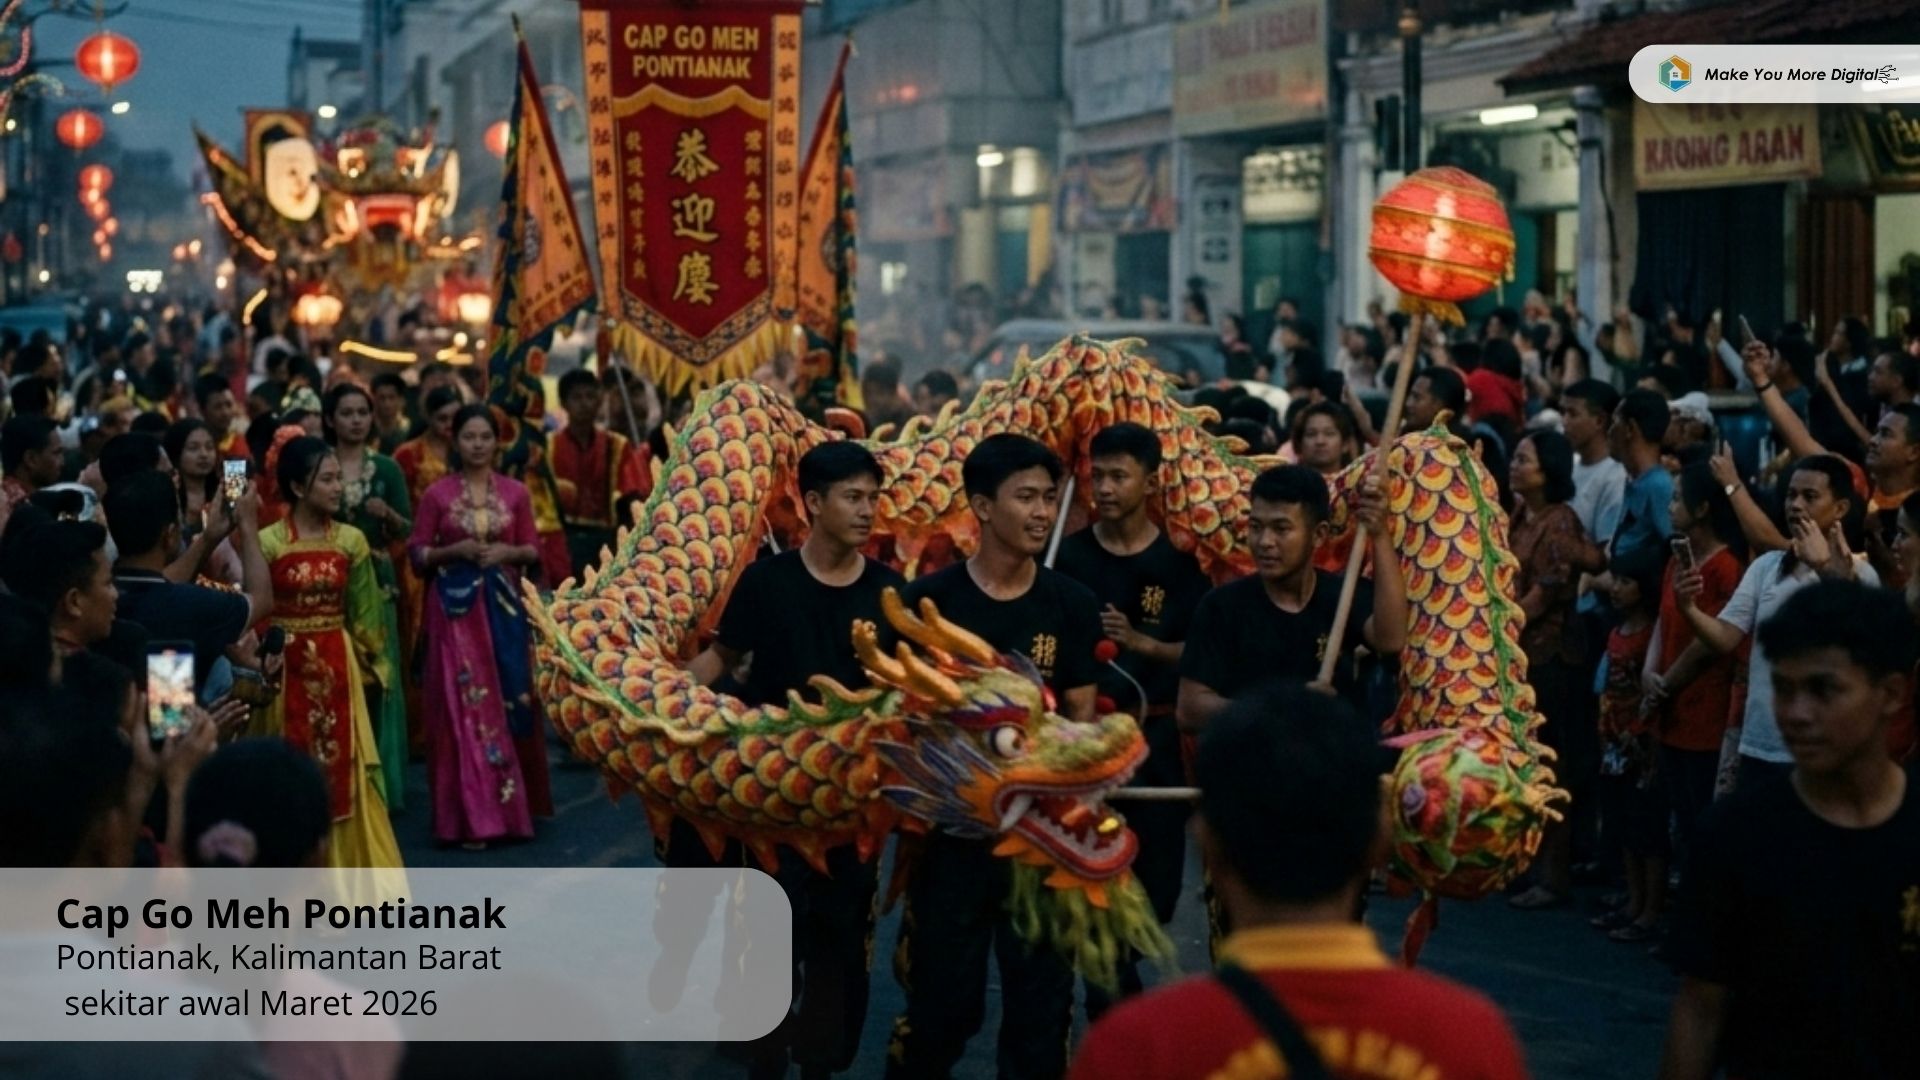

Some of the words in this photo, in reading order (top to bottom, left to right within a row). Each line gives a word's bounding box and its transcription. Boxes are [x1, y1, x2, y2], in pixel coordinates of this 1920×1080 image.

[624, 24, 668, 49] CAP
[674, 25, 706, 50] GO
[712, 26, 760, 51] MEH
[633, 55, 752, 79] PONTIANAK
